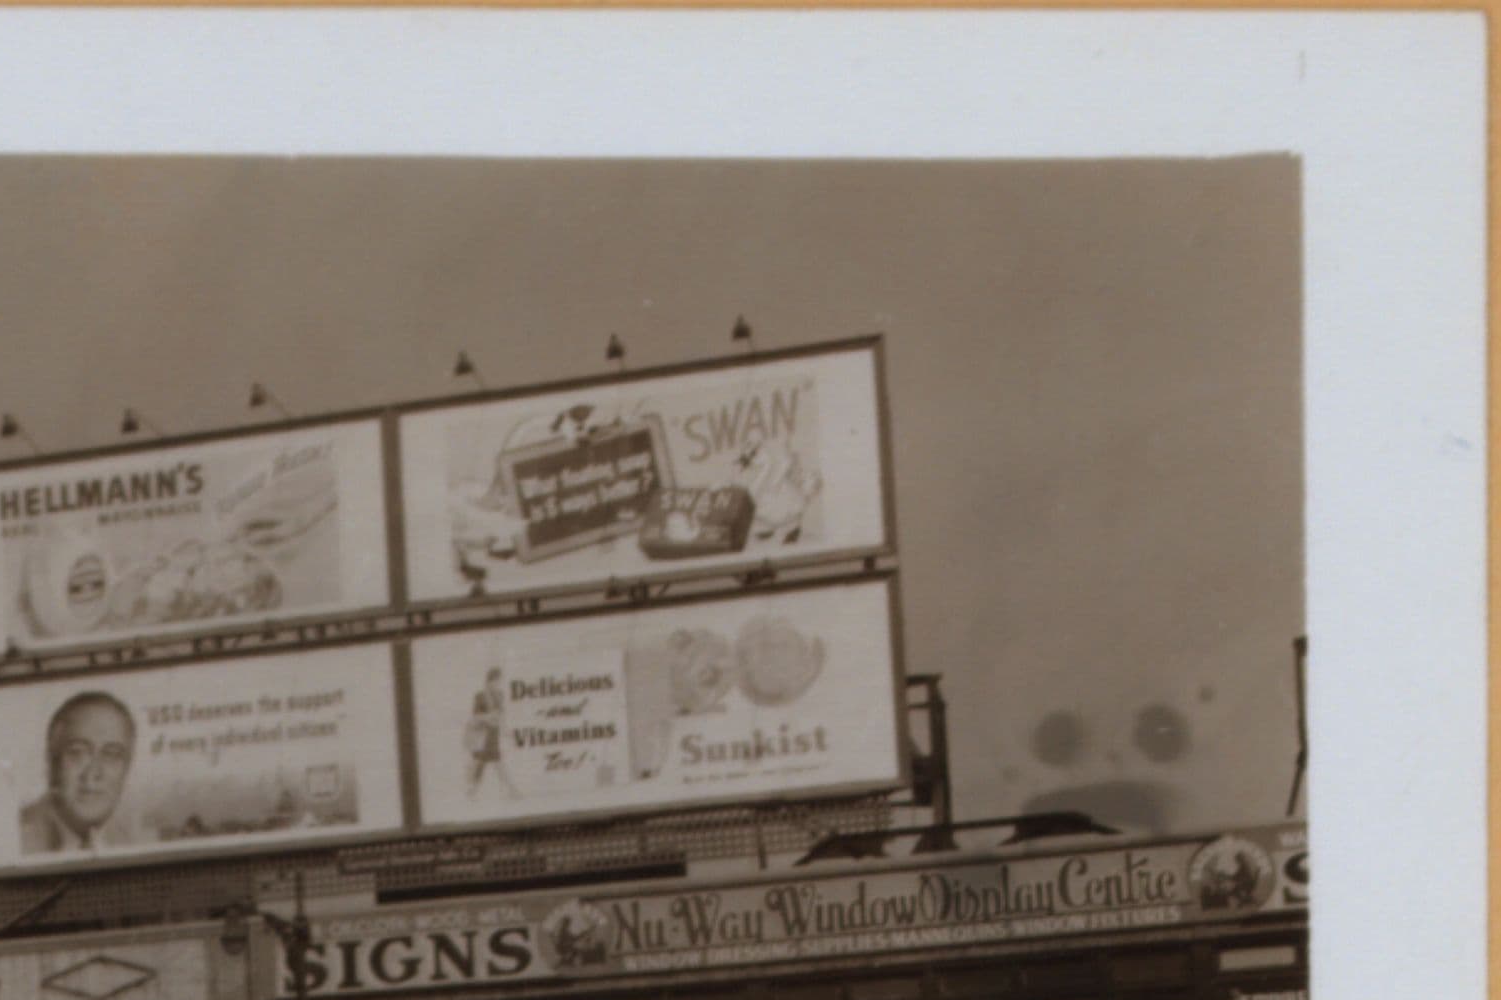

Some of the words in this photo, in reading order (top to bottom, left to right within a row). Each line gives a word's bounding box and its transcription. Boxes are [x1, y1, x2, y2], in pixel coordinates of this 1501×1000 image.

[0, 462, 204, 520] HELLMANN'S
[187, 699, 253, 722] deserves
[257, 693, 282, 713] the
[286, 687, 346, 713] support
[509, 672, 614, 703] Delicious
[512, 721, 617, 748] Vitamins
[679, 722, 829, 767] Sunkist
[764, 880, 919, 939] Window
[919, 865, 1056, 924] Display
[1058, 852, 1177, 908] Centre
[1093, 906, 1181, 930] FIXTURES
[283, 926, 533, 996] SIGNS
